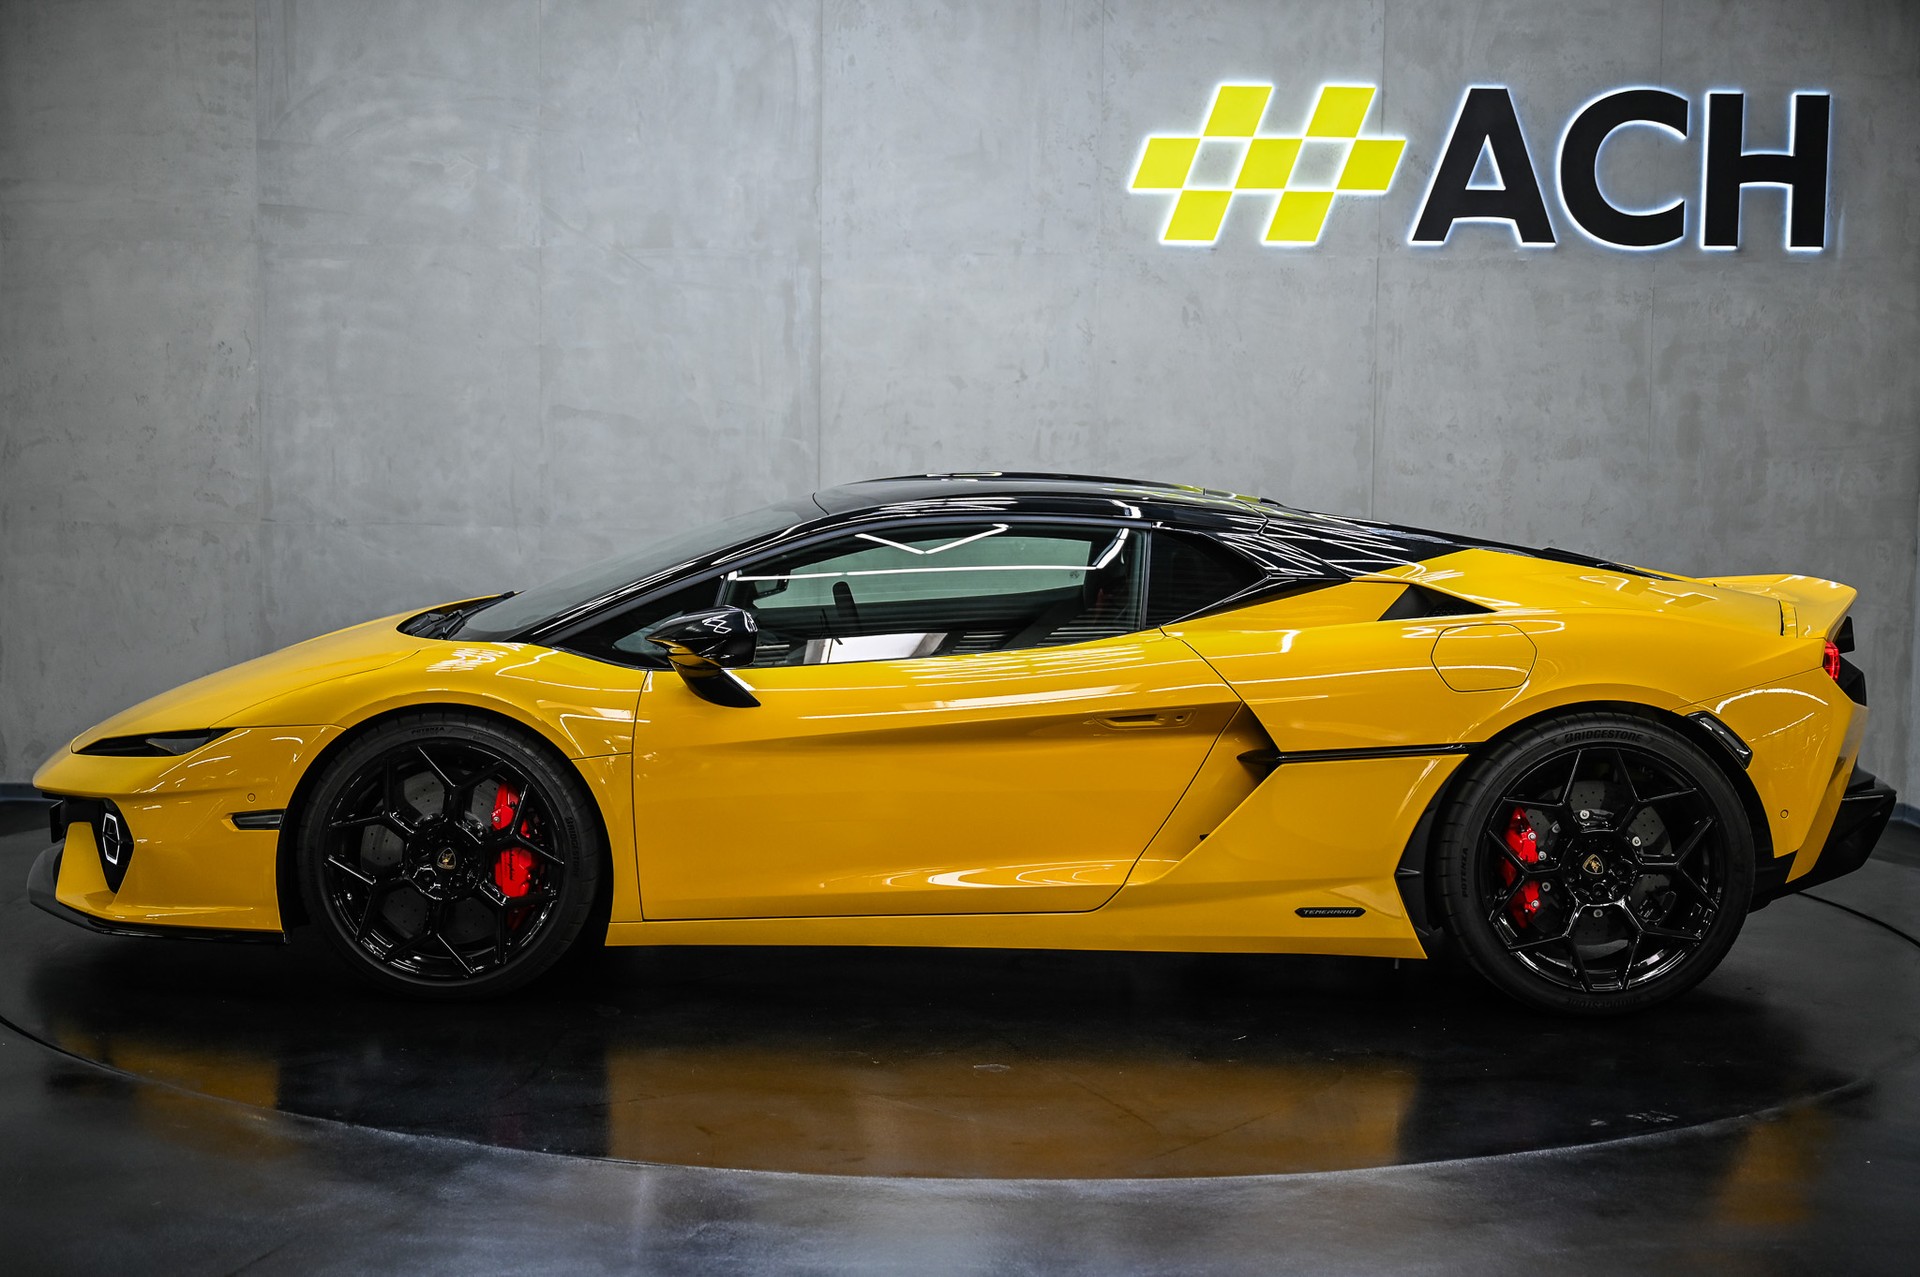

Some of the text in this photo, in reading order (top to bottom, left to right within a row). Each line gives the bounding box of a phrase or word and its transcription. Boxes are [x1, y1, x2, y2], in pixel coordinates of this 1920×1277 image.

[1411, 87, 1830, 249] ACH
[1564, 729, 1643, 743] BRIDGESTONE
[1461, 847, 1469, 898] POTENZA
